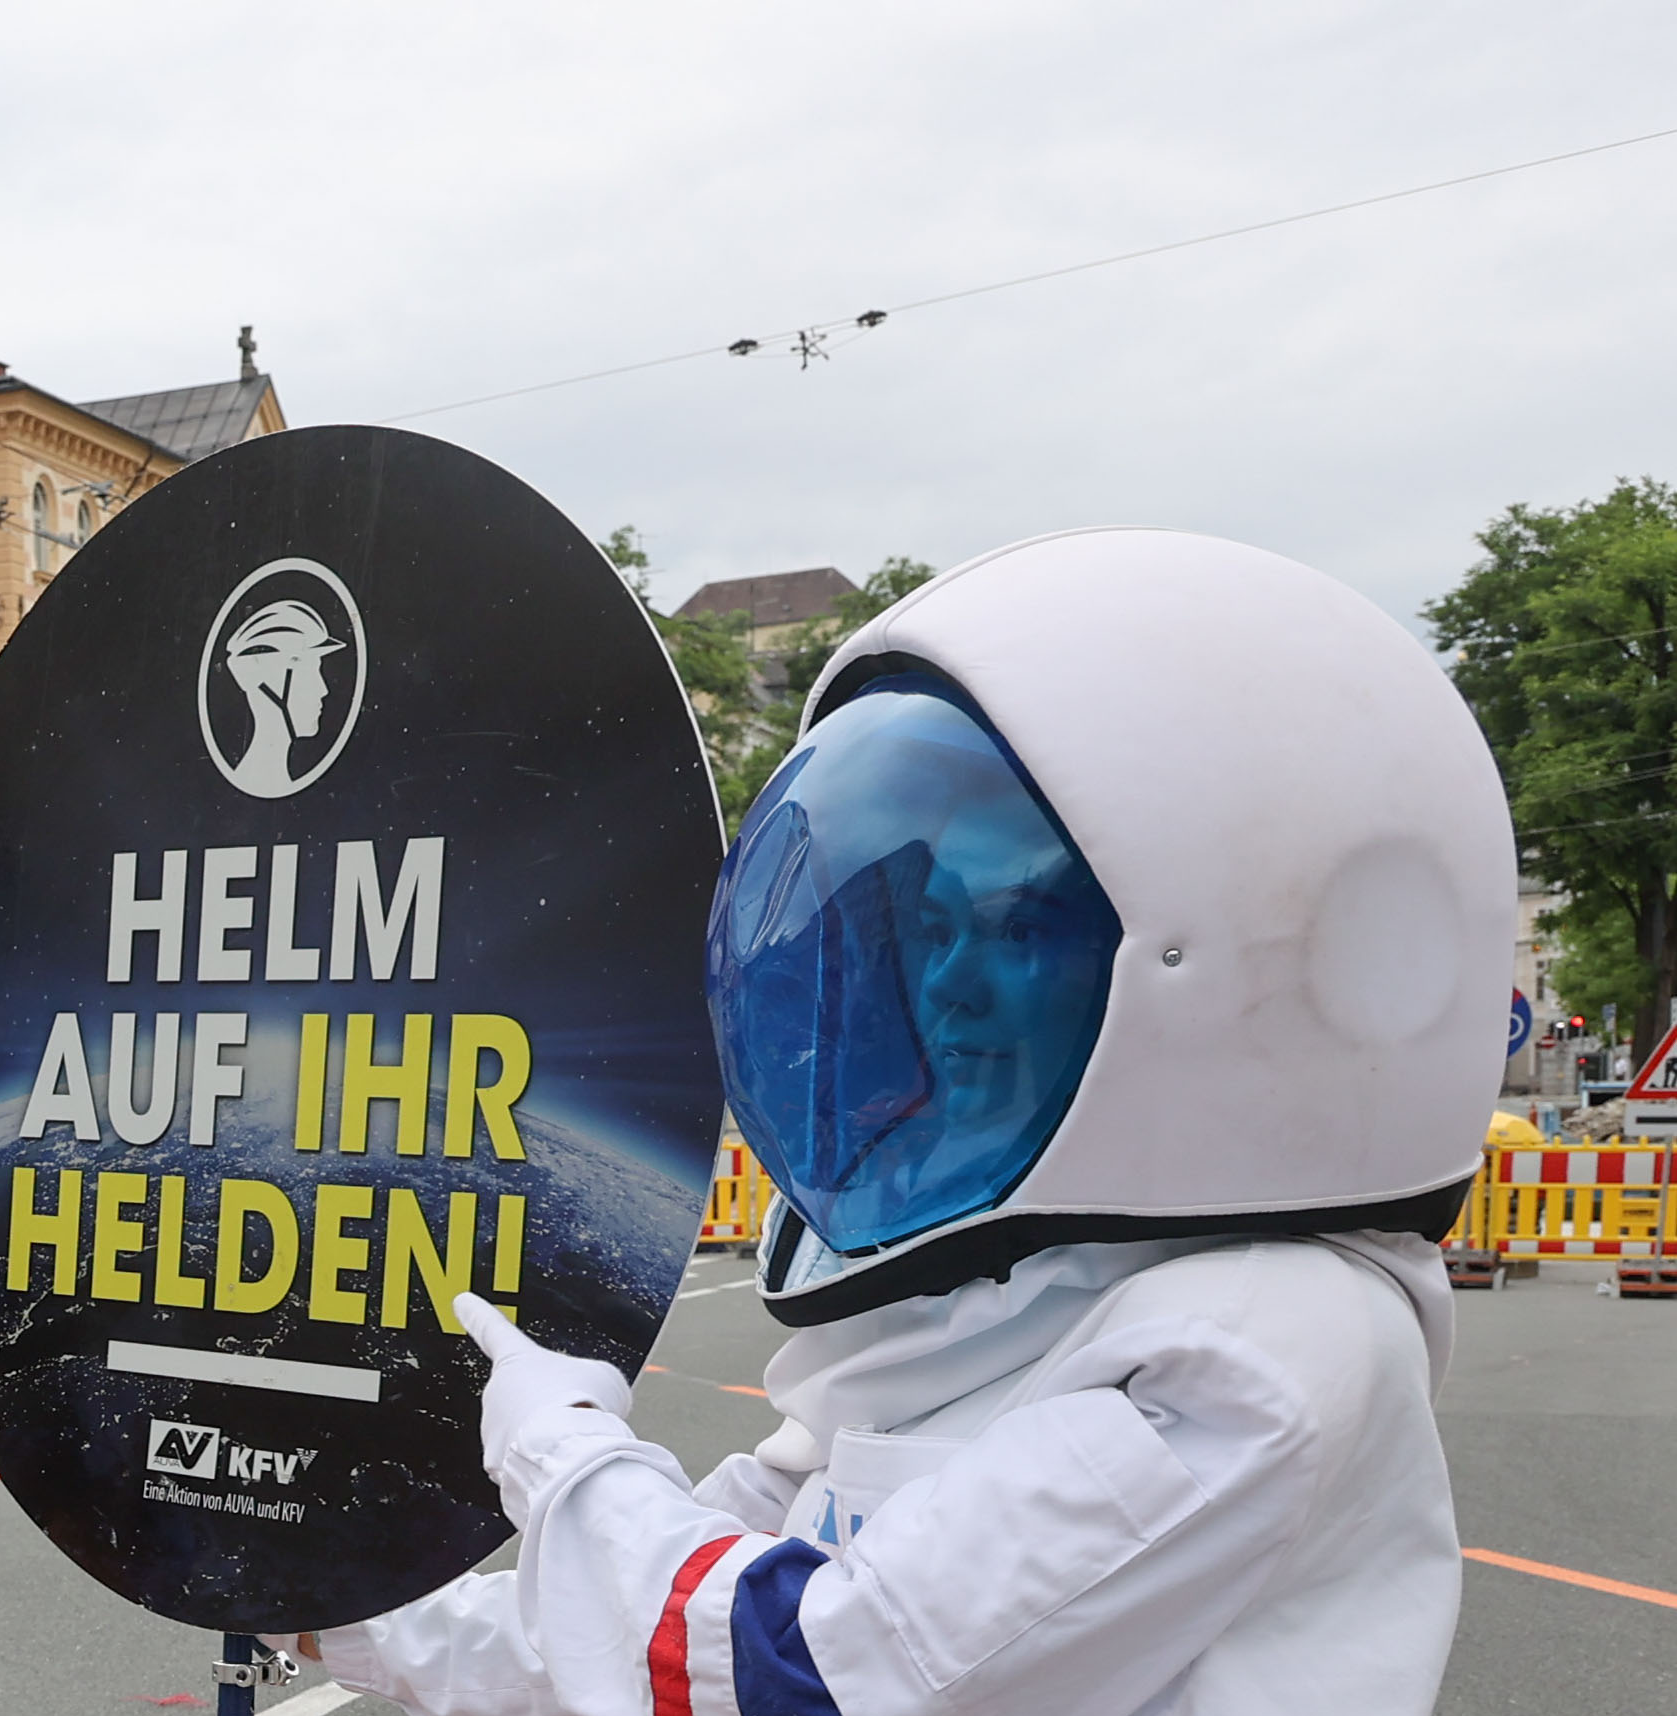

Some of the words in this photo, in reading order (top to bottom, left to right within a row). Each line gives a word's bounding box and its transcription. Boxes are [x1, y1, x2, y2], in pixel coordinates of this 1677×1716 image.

[107, 836, 445, 982] HELM
[18, 1012, 248, 1146] AUF
[294, 1013, 532, 1160] IHR
[6, 1167, 528, 1336] HELDEN!
[143, 1479, 166, 1501] Eine
[166, 1483, 201, 1508] Aktion
[202, 1494, 223, 1511] von
[223, 1492, 255, 1517] AUVA
[256, 1500, 281, 1520] und
[281, 1501, 306, 1525] KFV
[228, 1445, 299, 1486] KFV
